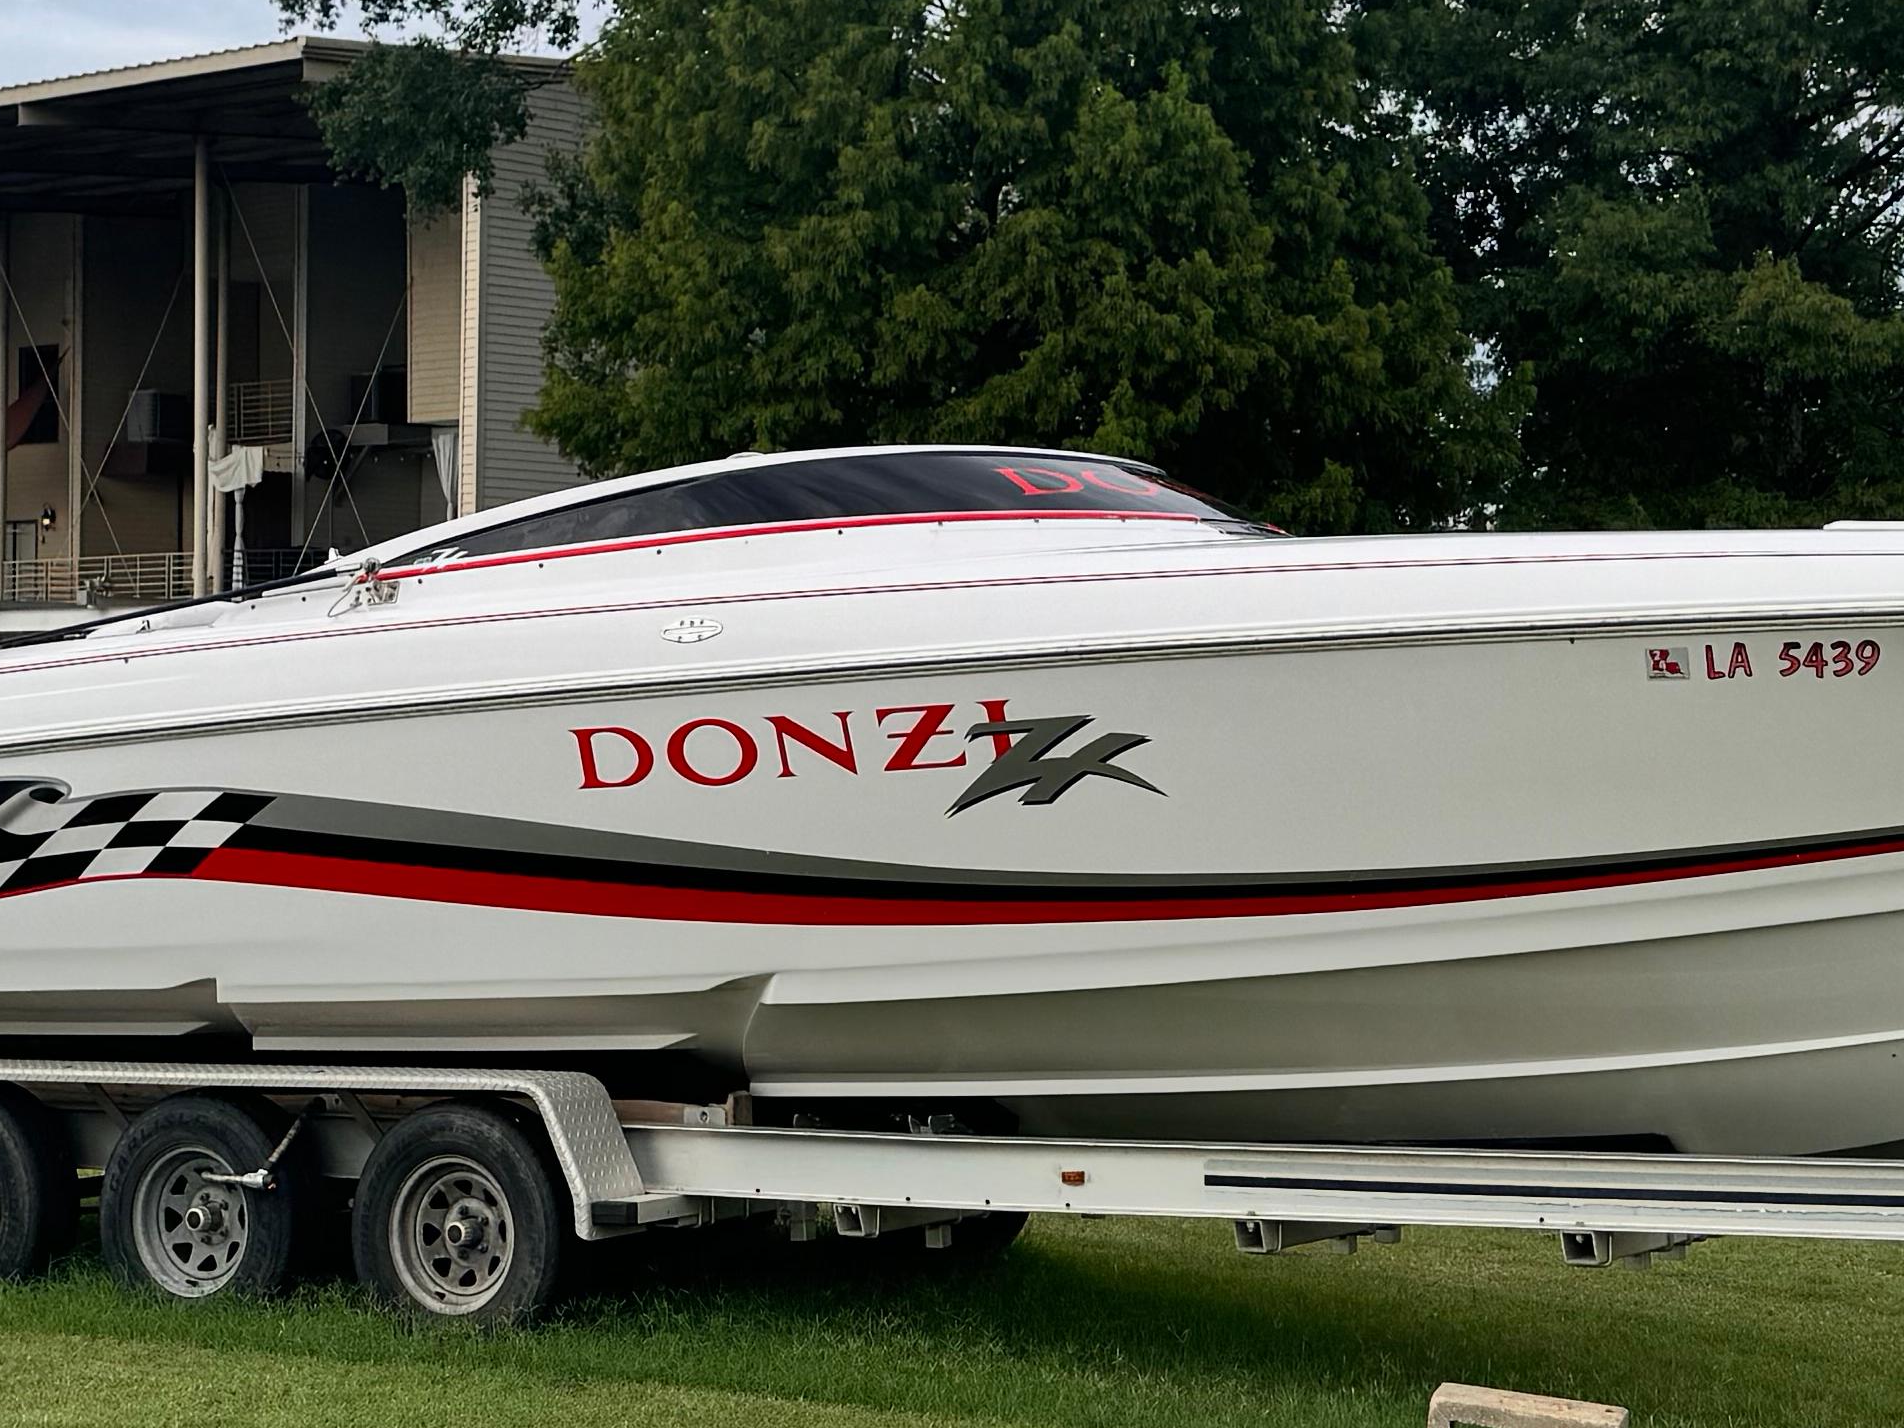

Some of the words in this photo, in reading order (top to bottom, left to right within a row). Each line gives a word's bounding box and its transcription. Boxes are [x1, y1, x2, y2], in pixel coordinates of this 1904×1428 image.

[1704, 644, 1753, 680] LA
[1778, 639, 1881, 679] 5439
[568, 699, 1012, 790] DONZI
